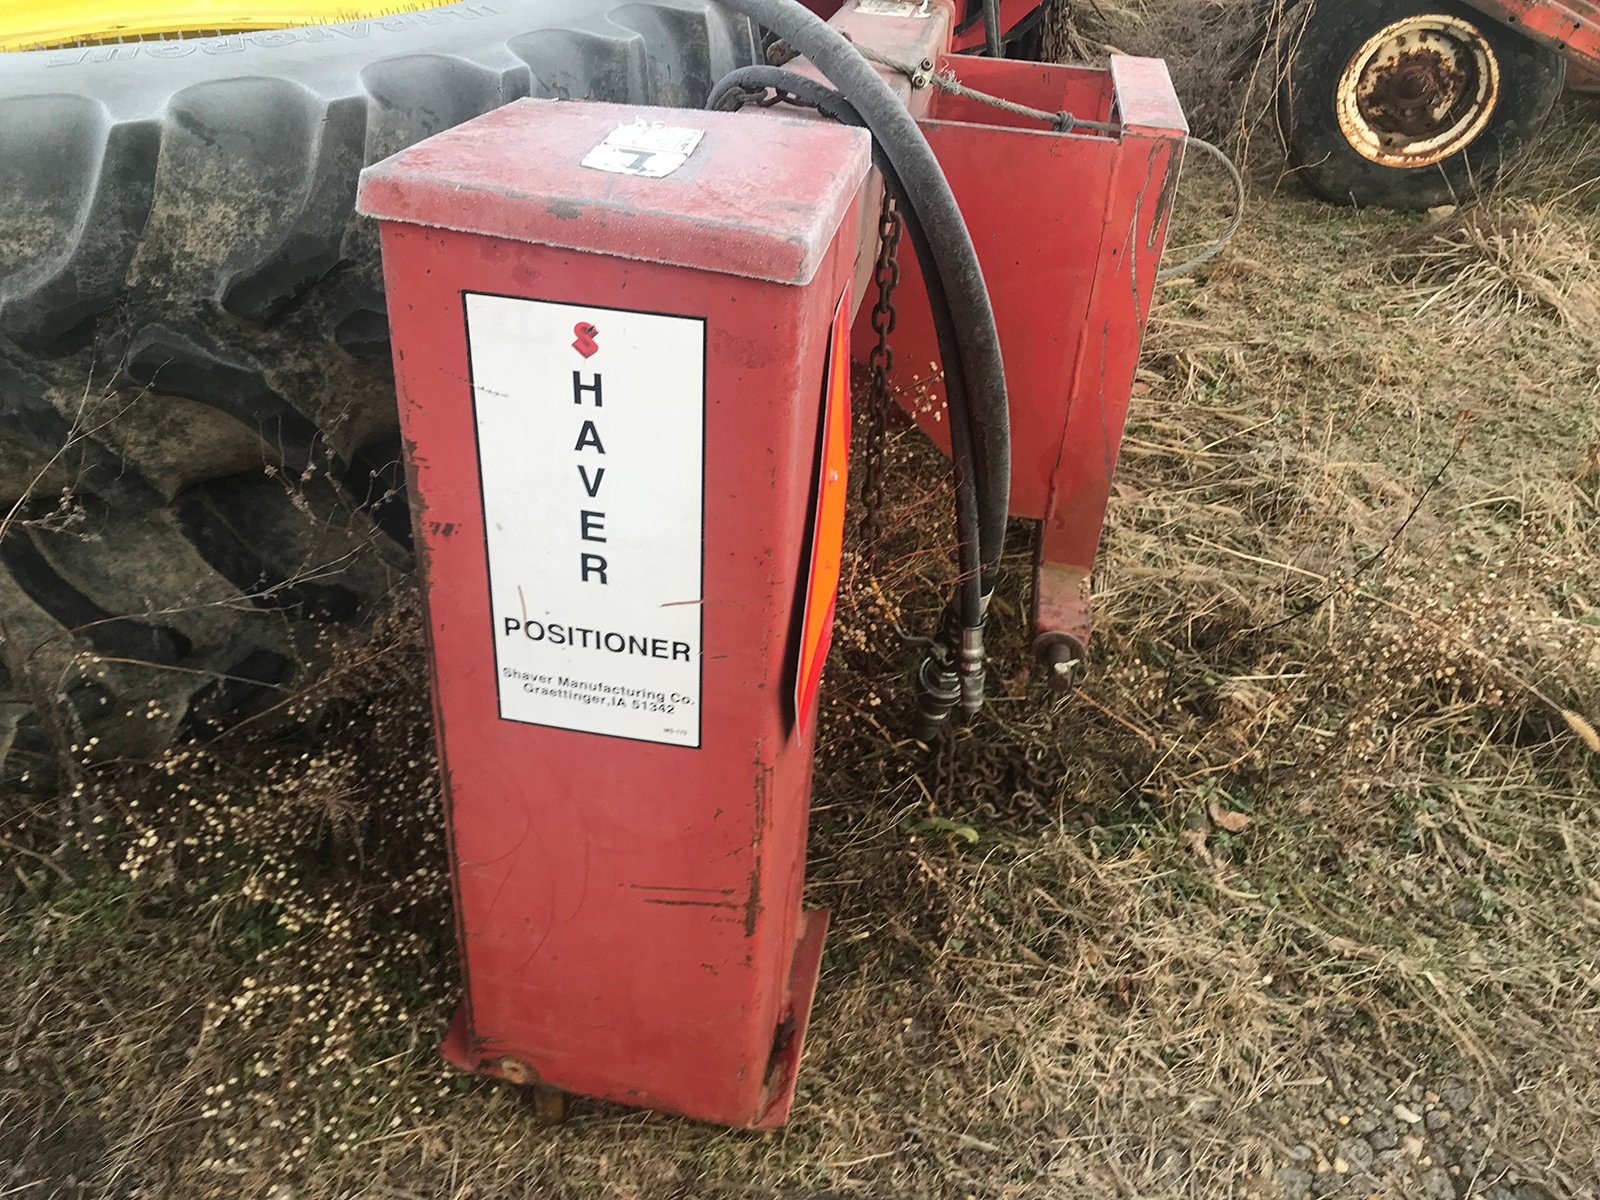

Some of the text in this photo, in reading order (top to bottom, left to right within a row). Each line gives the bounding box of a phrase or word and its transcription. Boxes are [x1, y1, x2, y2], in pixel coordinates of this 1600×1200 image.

[504, 617, 690, 662] POSITIONER
[503, 667, 695, 706] Shaver Manufacturing Co.
[632, 700, 675, 715] 51342
